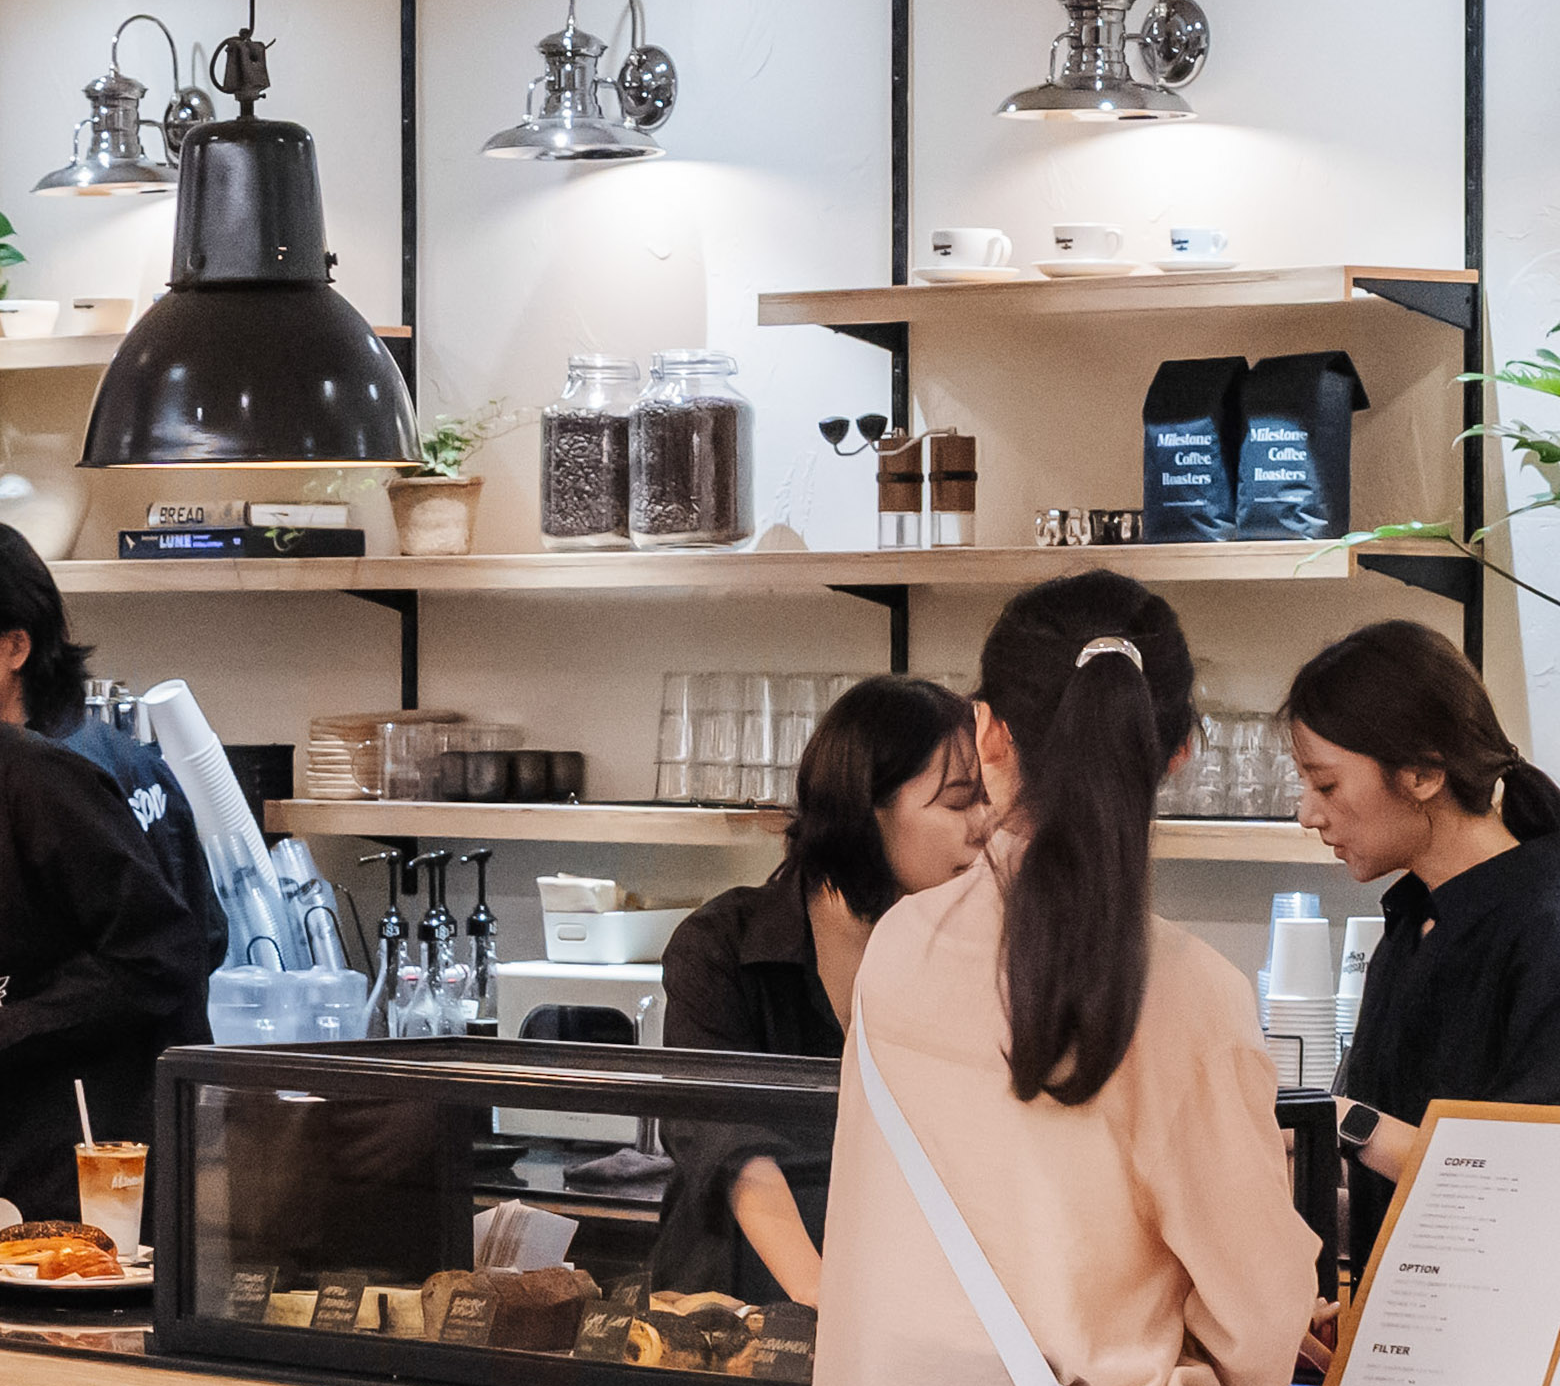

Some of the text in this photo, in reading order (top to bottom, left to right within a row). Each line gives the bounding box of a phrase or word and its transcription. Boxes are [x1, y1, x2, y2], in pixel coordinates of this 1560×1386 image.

[1157, 433, 1212, 447] Milestone
[1250, 427, 1308, 442] Milestone
[1175, 452, 1212, 465] Coffee
[1268, 447, 1307, 461] Coffee
[1161, 472, 1212, 486] Roasters
[1254, 467, 1306, 481] Roasters
[160, 507, 204, 524] BREAD
[1444, 1157, 1487, 1169] COFFEE
[1398, 1263, 1440, 1274] OPTION
[1372, 1343, 1411, 1355] FILTER
